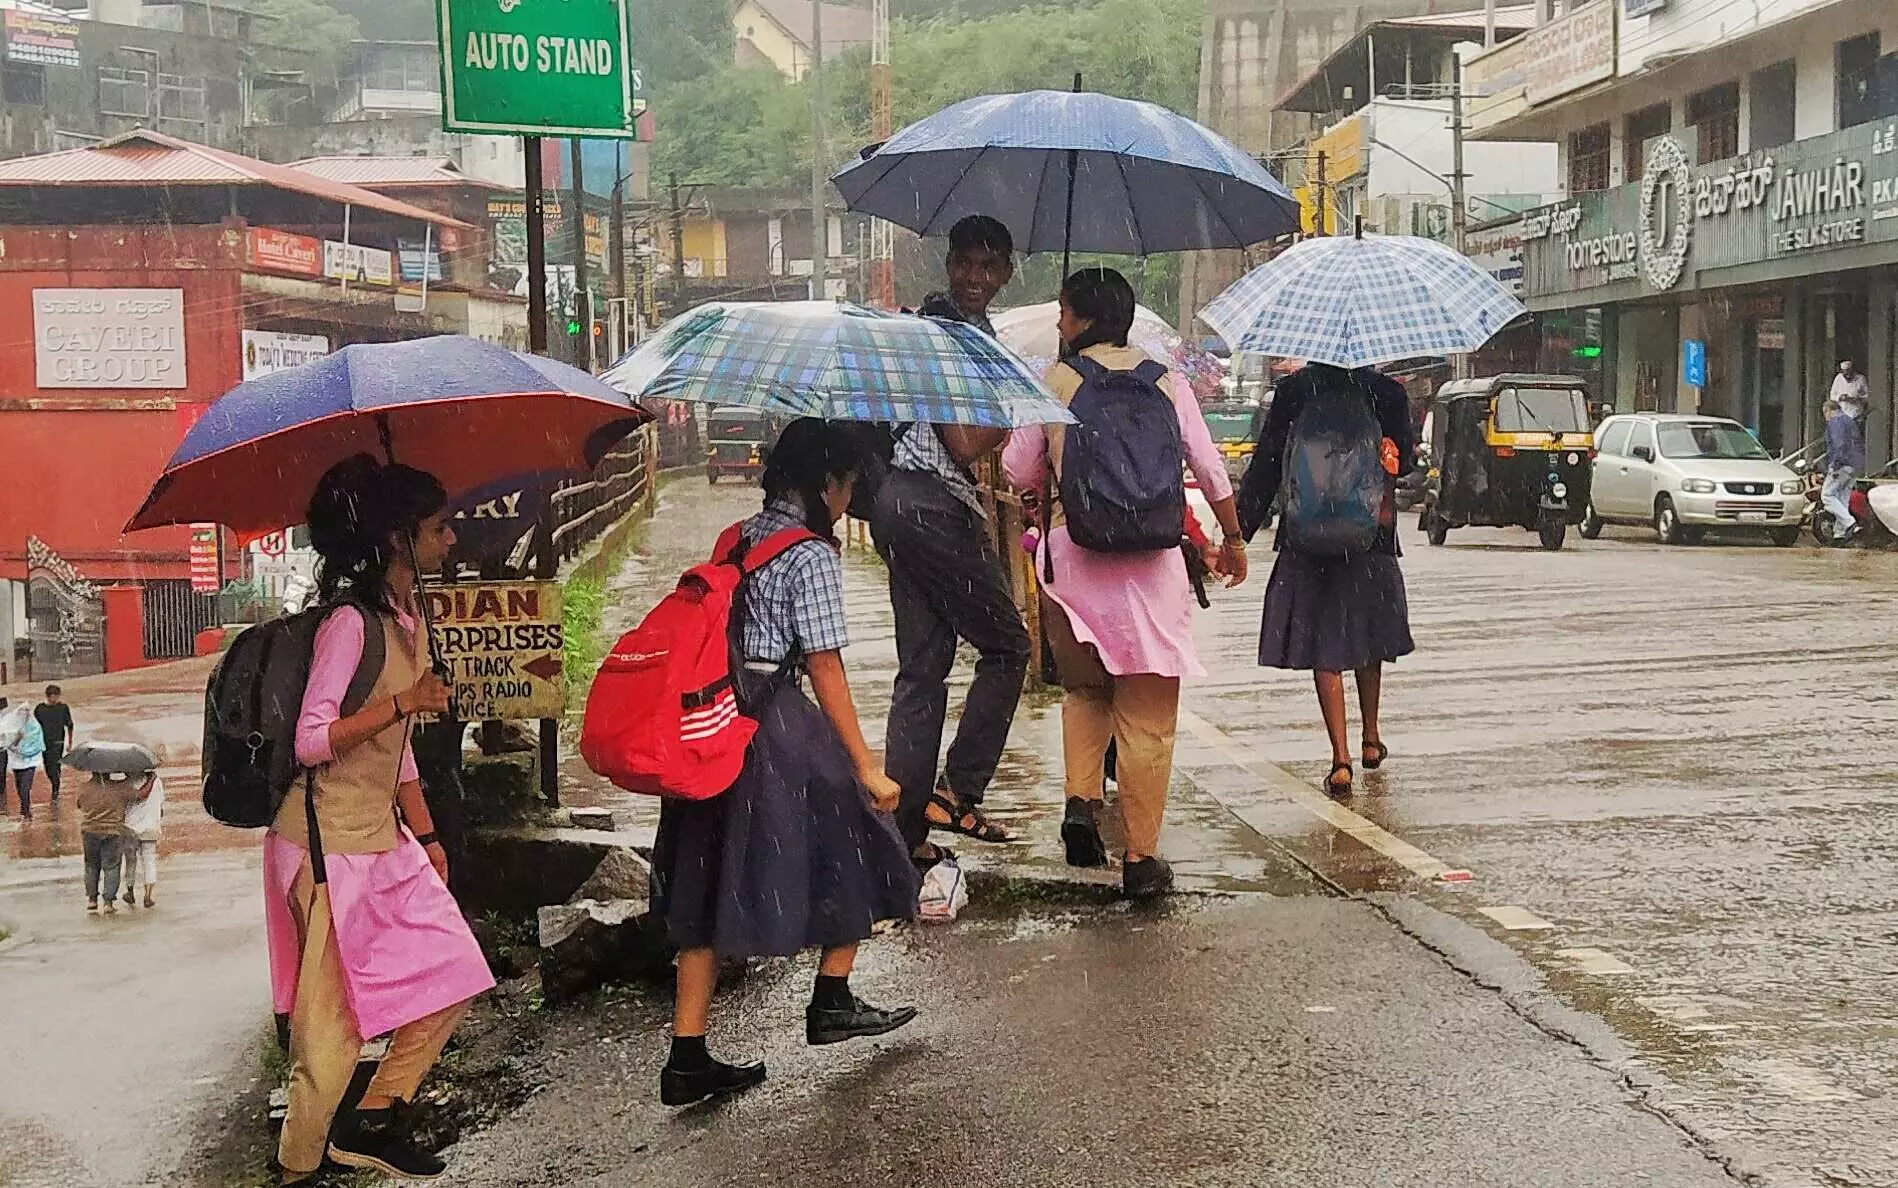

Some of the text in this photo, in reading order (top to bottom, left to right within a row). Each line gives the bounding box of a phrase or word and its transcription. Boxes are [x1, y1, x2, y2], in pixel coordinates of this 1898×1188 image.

[465, 31, 612, 76] AUTO STAND
[1821, 217, 1863, 244] STORE
[45, 326, 175, 352] CAVERI
[55, 357, 172, 383] GROUP
[463, 655, 516, 677] TRACK
[483, 677, 533, 700] RADIO
